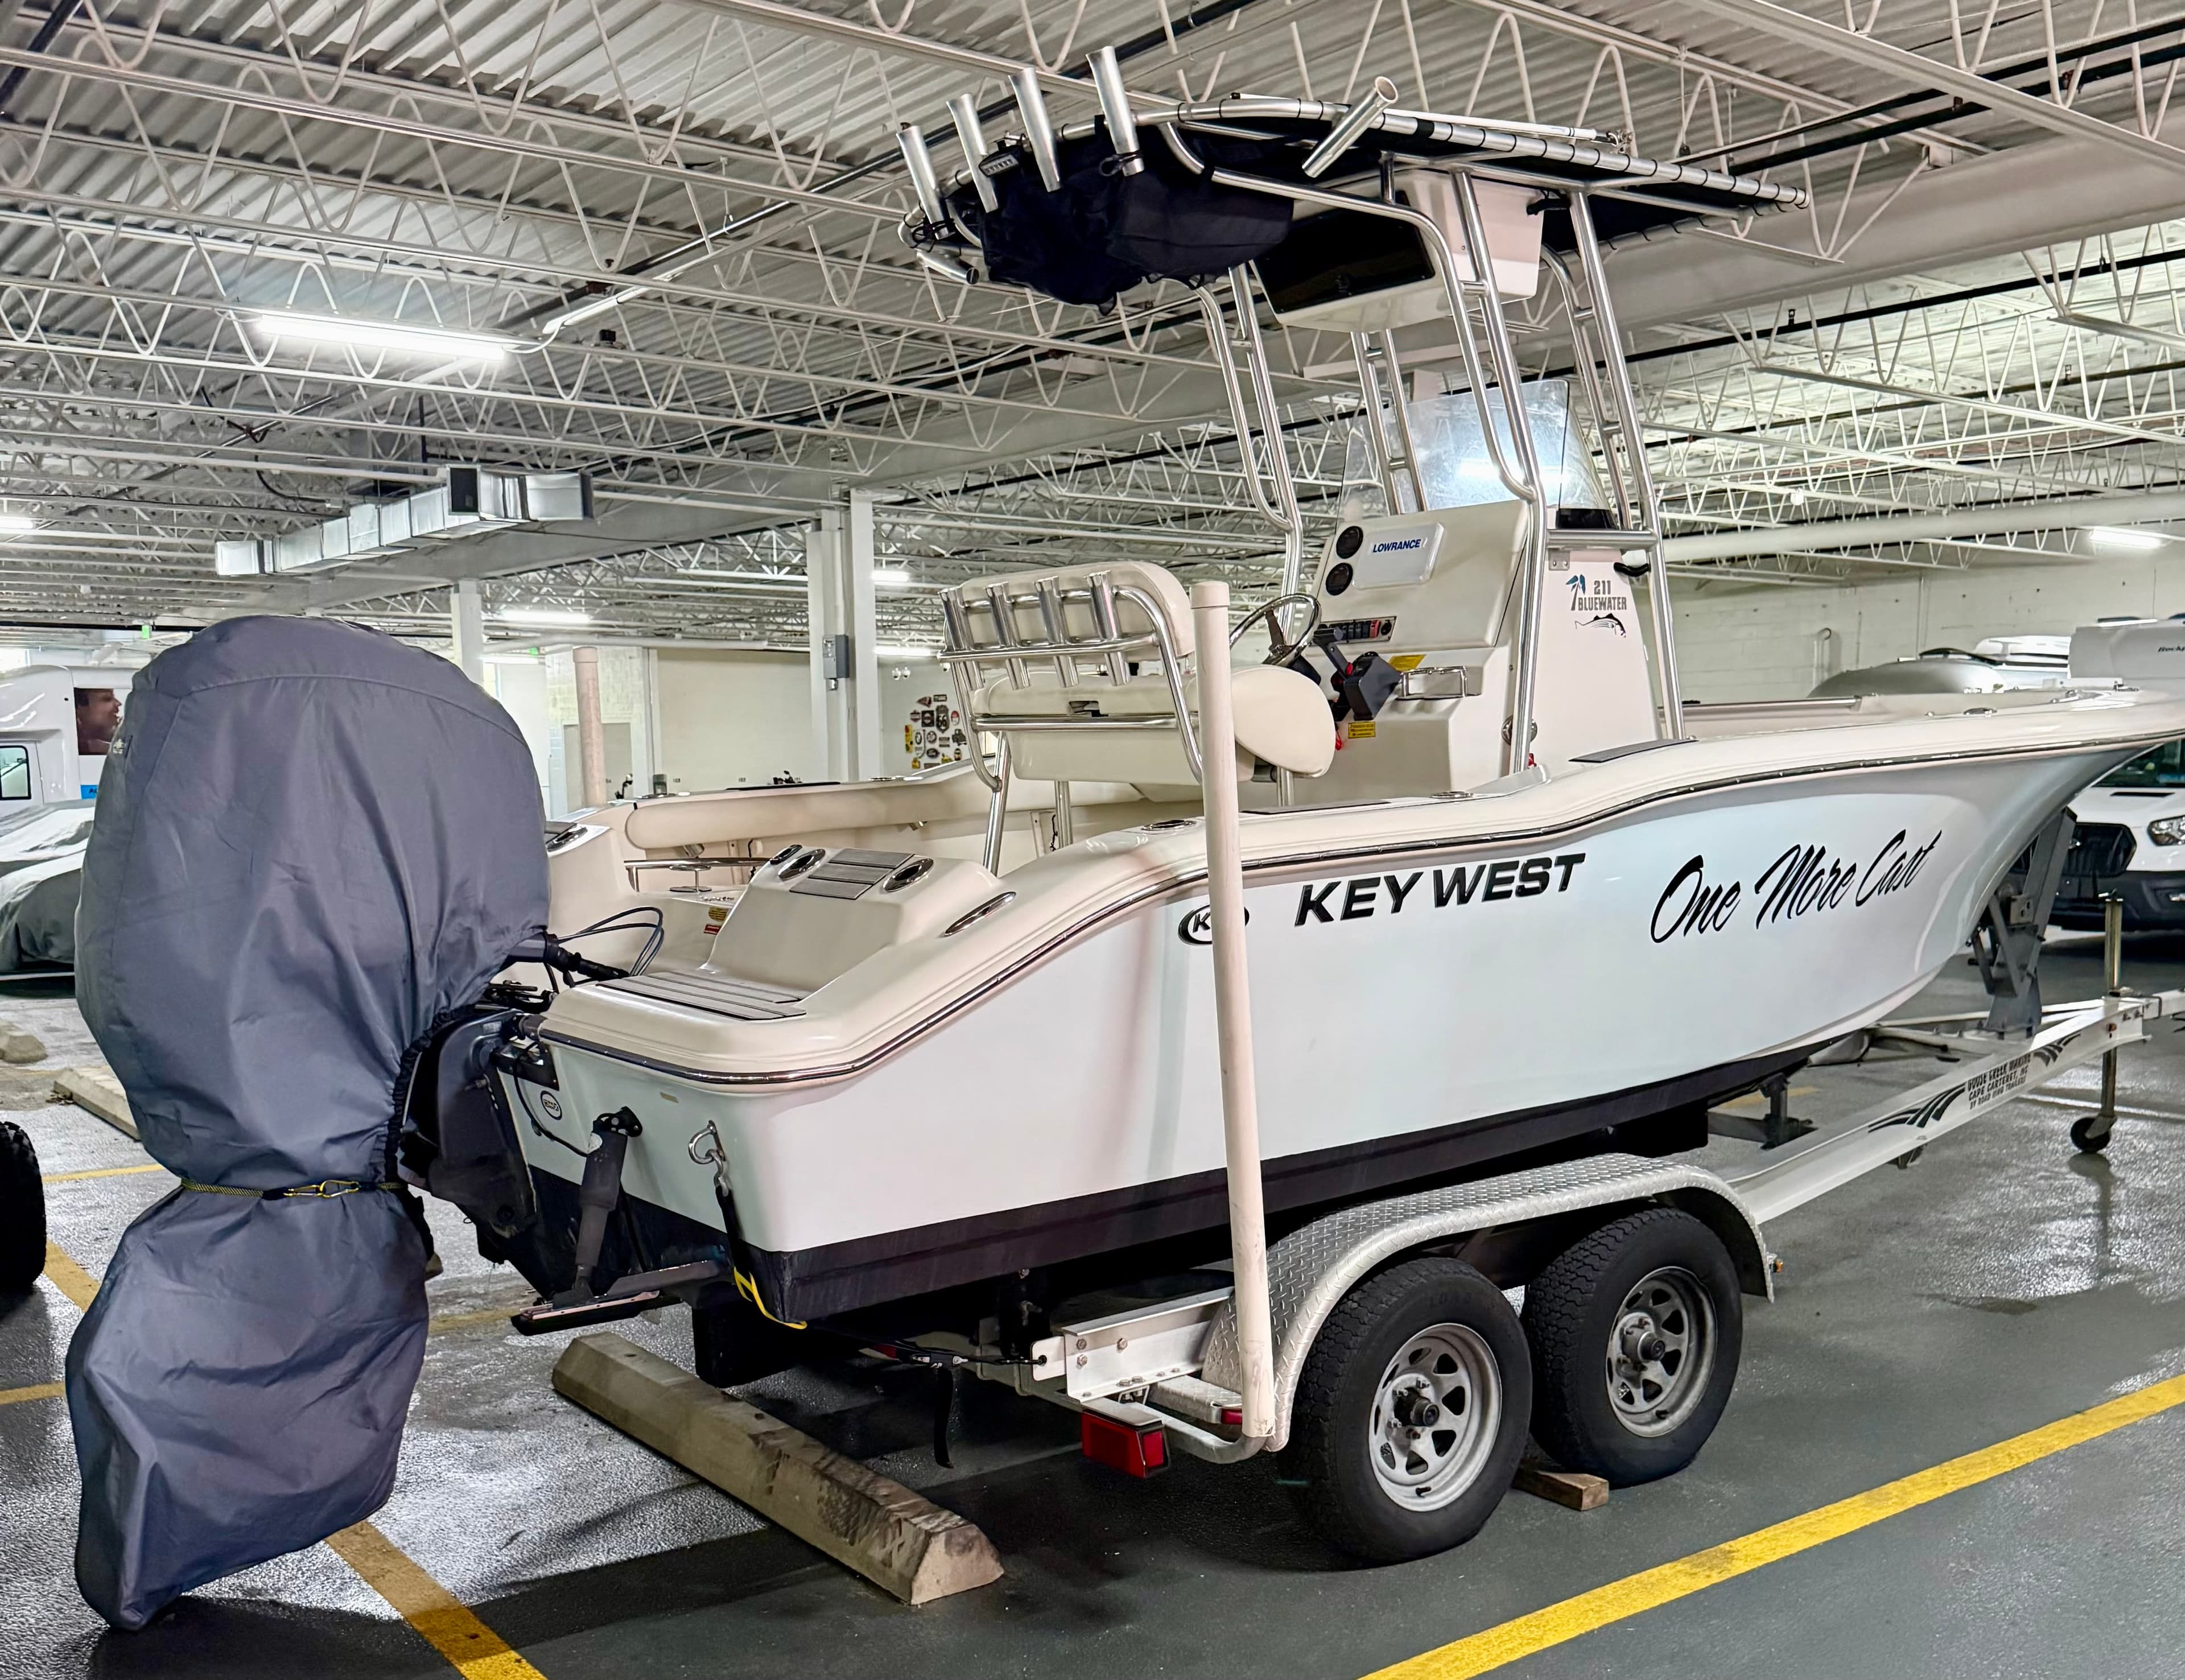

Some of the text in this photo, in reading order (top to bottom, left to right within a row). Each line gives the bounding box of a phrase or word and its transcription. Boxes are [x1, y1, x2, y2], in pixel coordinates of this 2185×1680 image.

[1372, 539, 1421, 553] LOWRANCE
[1594, 580, 1611, 595] 211
[1578, 597, 1627, 611] BLUEWATER
[937, 715, 947, 727] 66
[1294, 852, 1586, 927] KEY WEST
[1650, 828, 1943, 944] One More Cast
[1193, 911, 1211, 933] K
[1969, 1085, 1985, 1101] CAPE
